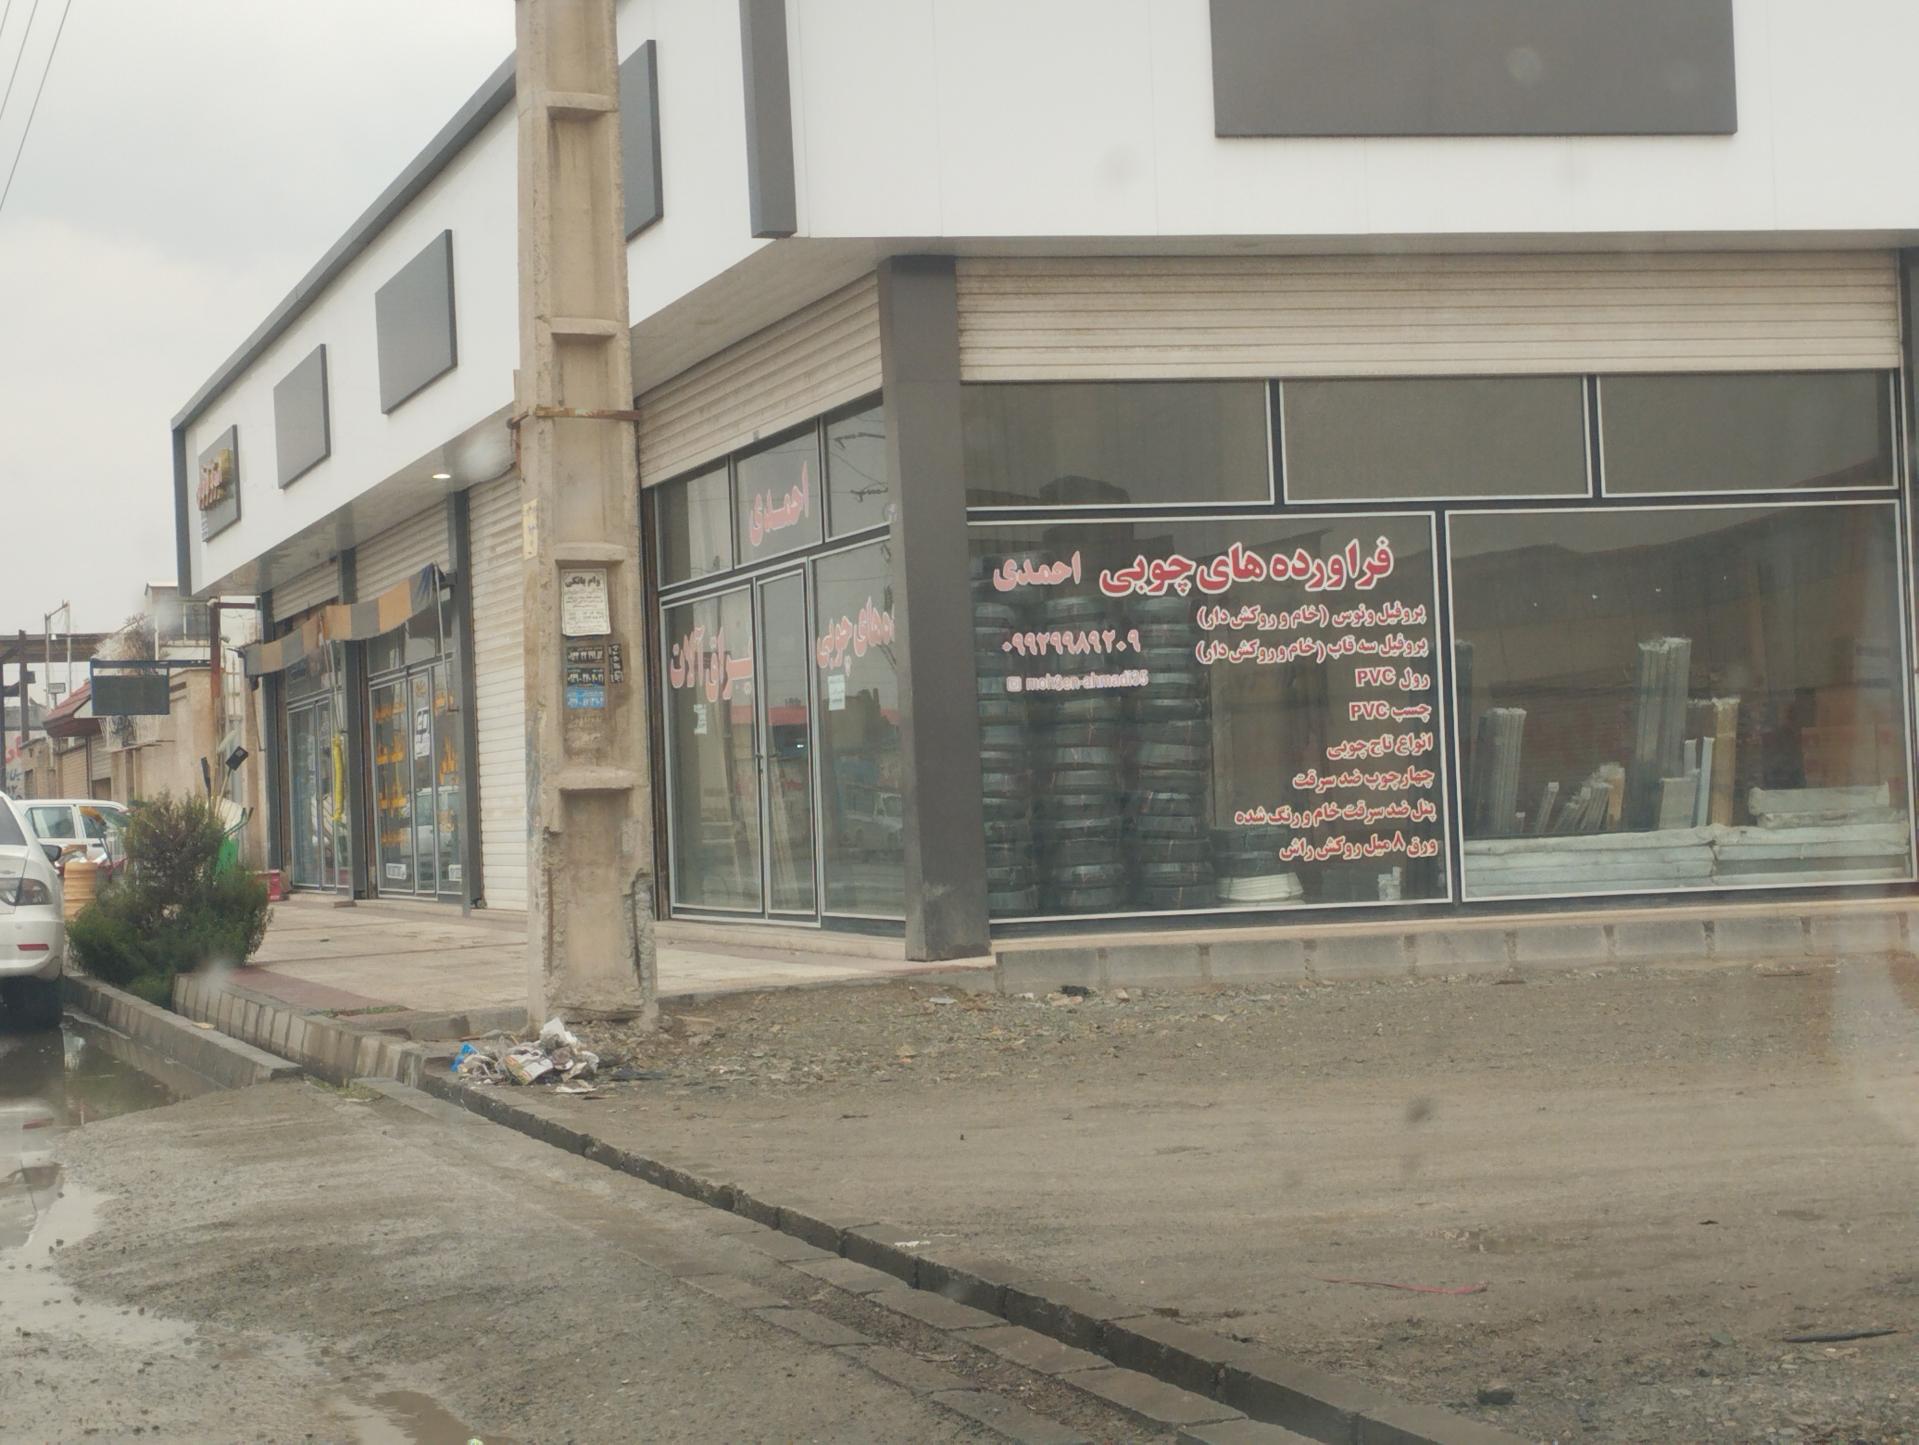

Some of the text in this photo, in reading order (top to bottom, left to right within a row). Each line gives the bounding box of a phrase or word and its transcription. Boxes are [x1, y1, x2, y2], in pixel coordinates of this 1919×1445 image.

[750, 460, 809, 547] احمدی
[993, 536, 1395, 597] فراورده های چوبی احمدی
[1230, 604, 1278, 630] روکش
[1279, 612, 1290, 629] و
[1332, 603, 1376, 627] ونوس
[1376, 601, 1427, 626] پروفیل
[817, 615, 853, 677] چوبی
[1276, 645, 1287, 662] و
[1327, 635, 1356, 660] قاب
[1358, 640, 1377, 655] سه
[1379, 632, 1429, 657] پروفیل
[1355, 667, 1431, 690] رول PVC
[1349, 701, 1432, 724] چسب PVC
[1327, 733, 1433, 760] انواع تاج چوبی
[1292, 768, 1337, 794] سرقت
[1337, 768, 1363, 788] ضد
[1234, 798, 1437, 828] پنل ضد سرقت خام و رنگ شده
[1279, 830, 1438, 861] ورق ۸ میل روکش راش
